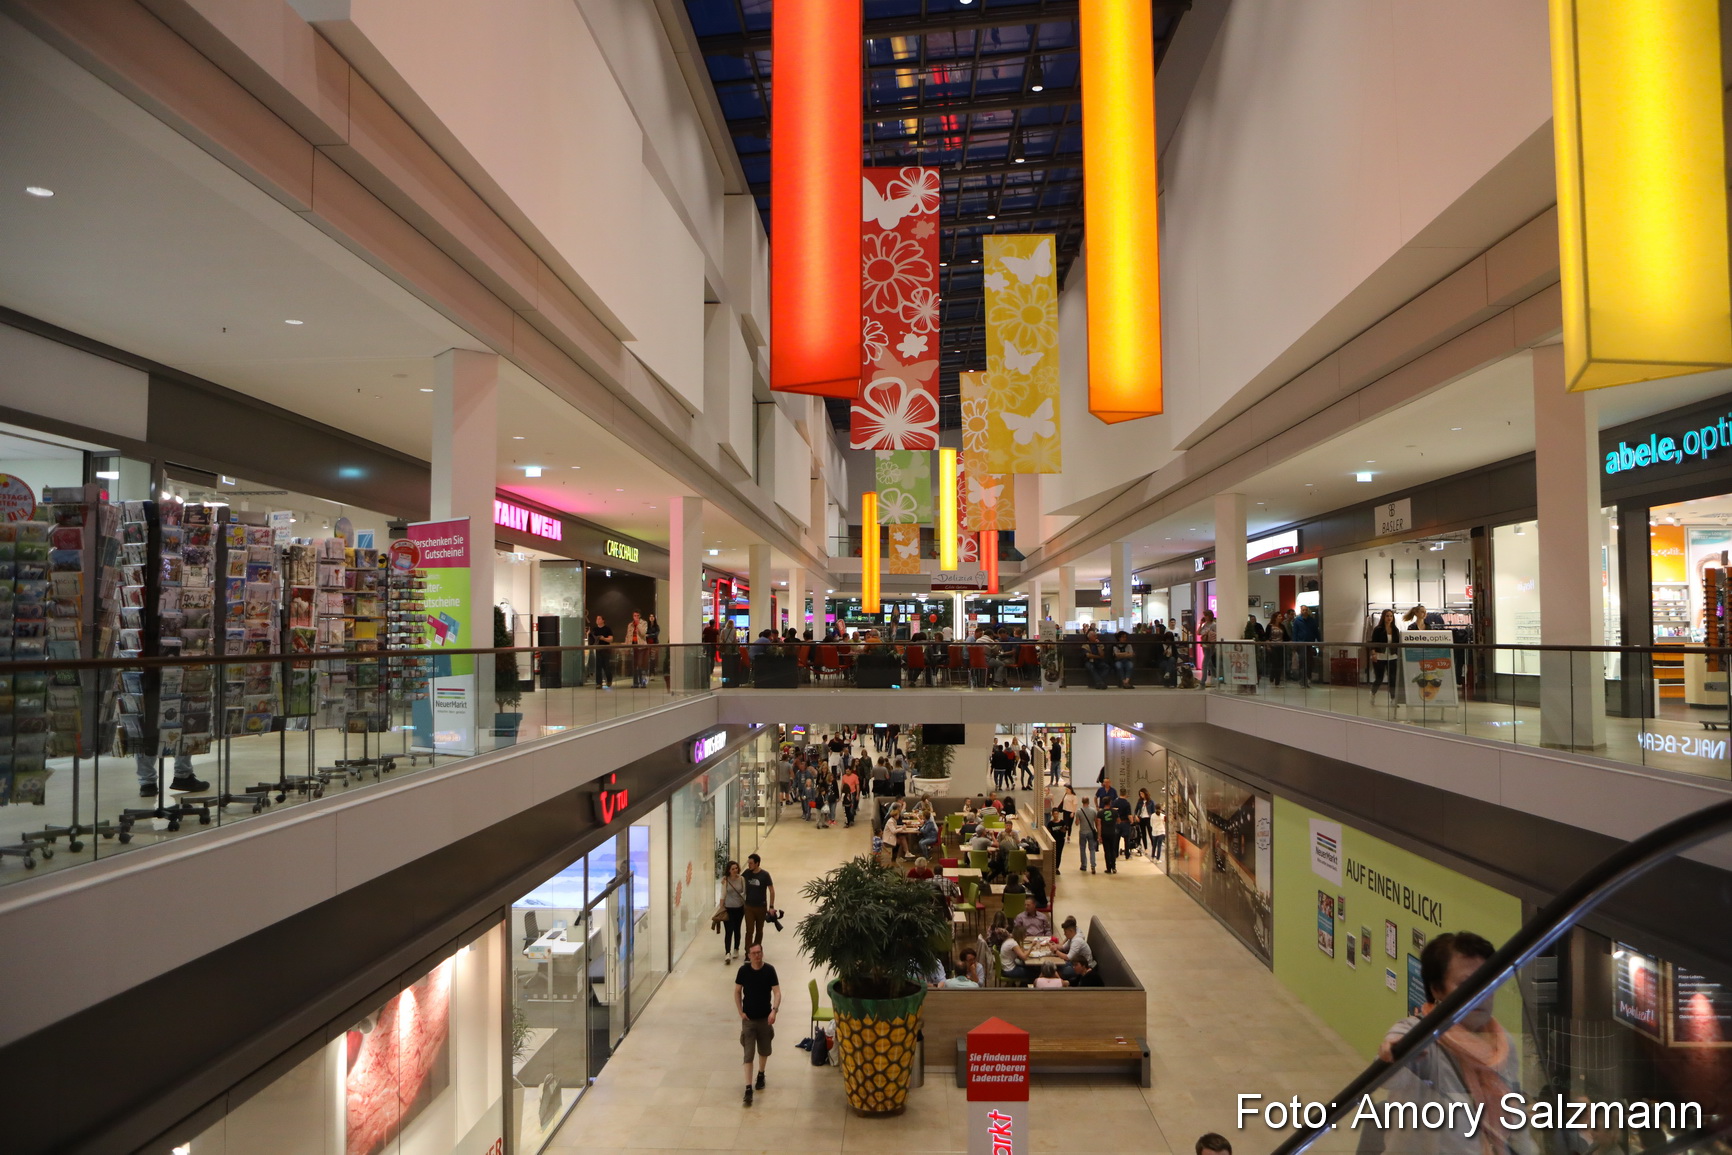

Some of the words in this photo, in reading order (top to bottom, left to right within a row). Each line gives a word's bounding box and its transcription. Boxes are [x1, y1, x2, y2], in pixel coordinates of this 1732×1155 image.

[1382, 518, 1404, 534] BASLER
[453, 534, 464, 545] Sie
[424, 547, 464, 560] Gutscheine!
[618, 544, 639, 563] SCHALLER
[933, 571, 973, 582] Delizia
[435, 700, 467, 709] NeuerMarkt
[616, 788, 628, 811] TUI
[1104, 810, 1112, 821] 2
[1315, 845, 1338, 865] NeuerMarkt
[1346, 857, 1366, 886] AUF
[1367, 868, 1401, 905] EINEN
[1403, 886, 1442, 927] BLICK!
[969, 1053, 981, 1061] Sie
[982, 1053, 1010, 1061] finden
[970, 1064, 978, 1072] in
[980, 1064, 994, 1072] der
[995, 1064, 1025, 1072] Oberen
[972, 1074, 1024, 1082] Ladenstraße
